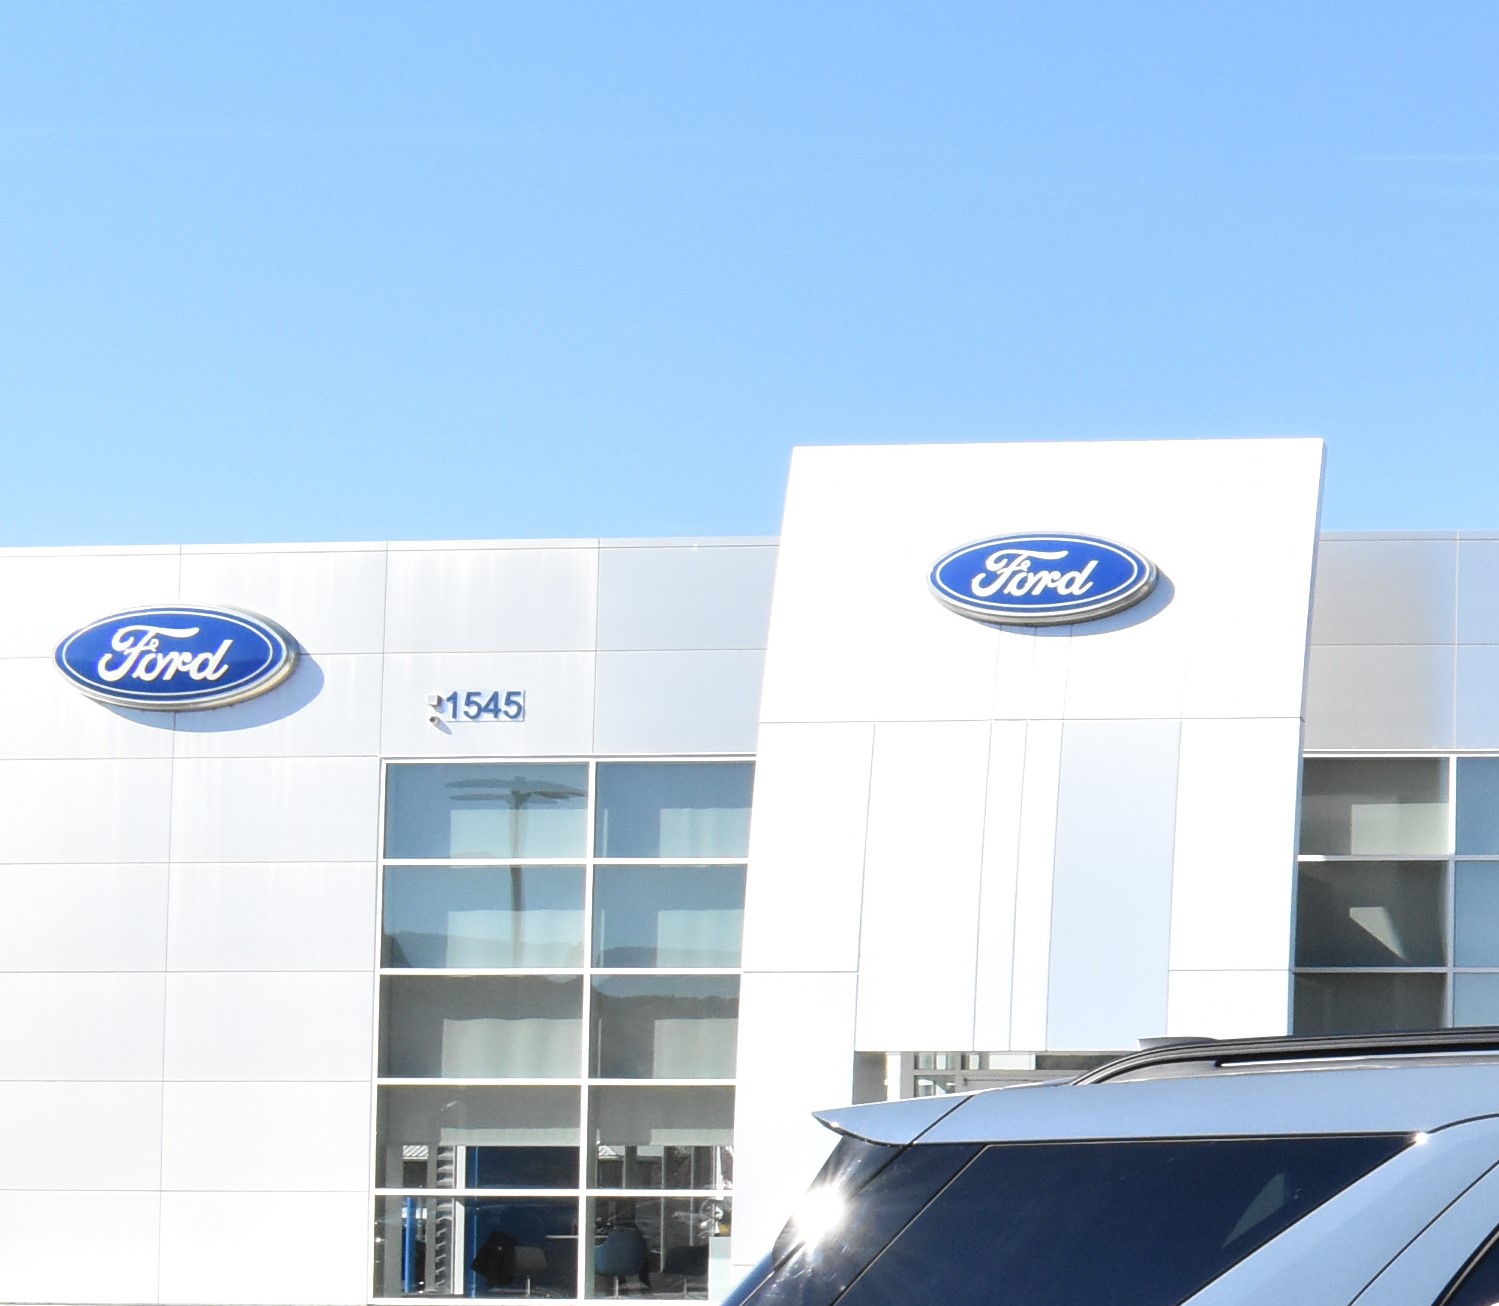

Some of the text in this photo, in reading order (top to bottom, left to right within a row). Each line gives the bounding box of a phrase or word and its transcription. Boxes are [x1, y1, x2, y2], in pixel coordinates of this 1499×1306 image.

[974, 548, 1099, 597] Ford
[97, 624, 234, 681] Ford
[446, 690, 523, 720] 1545
